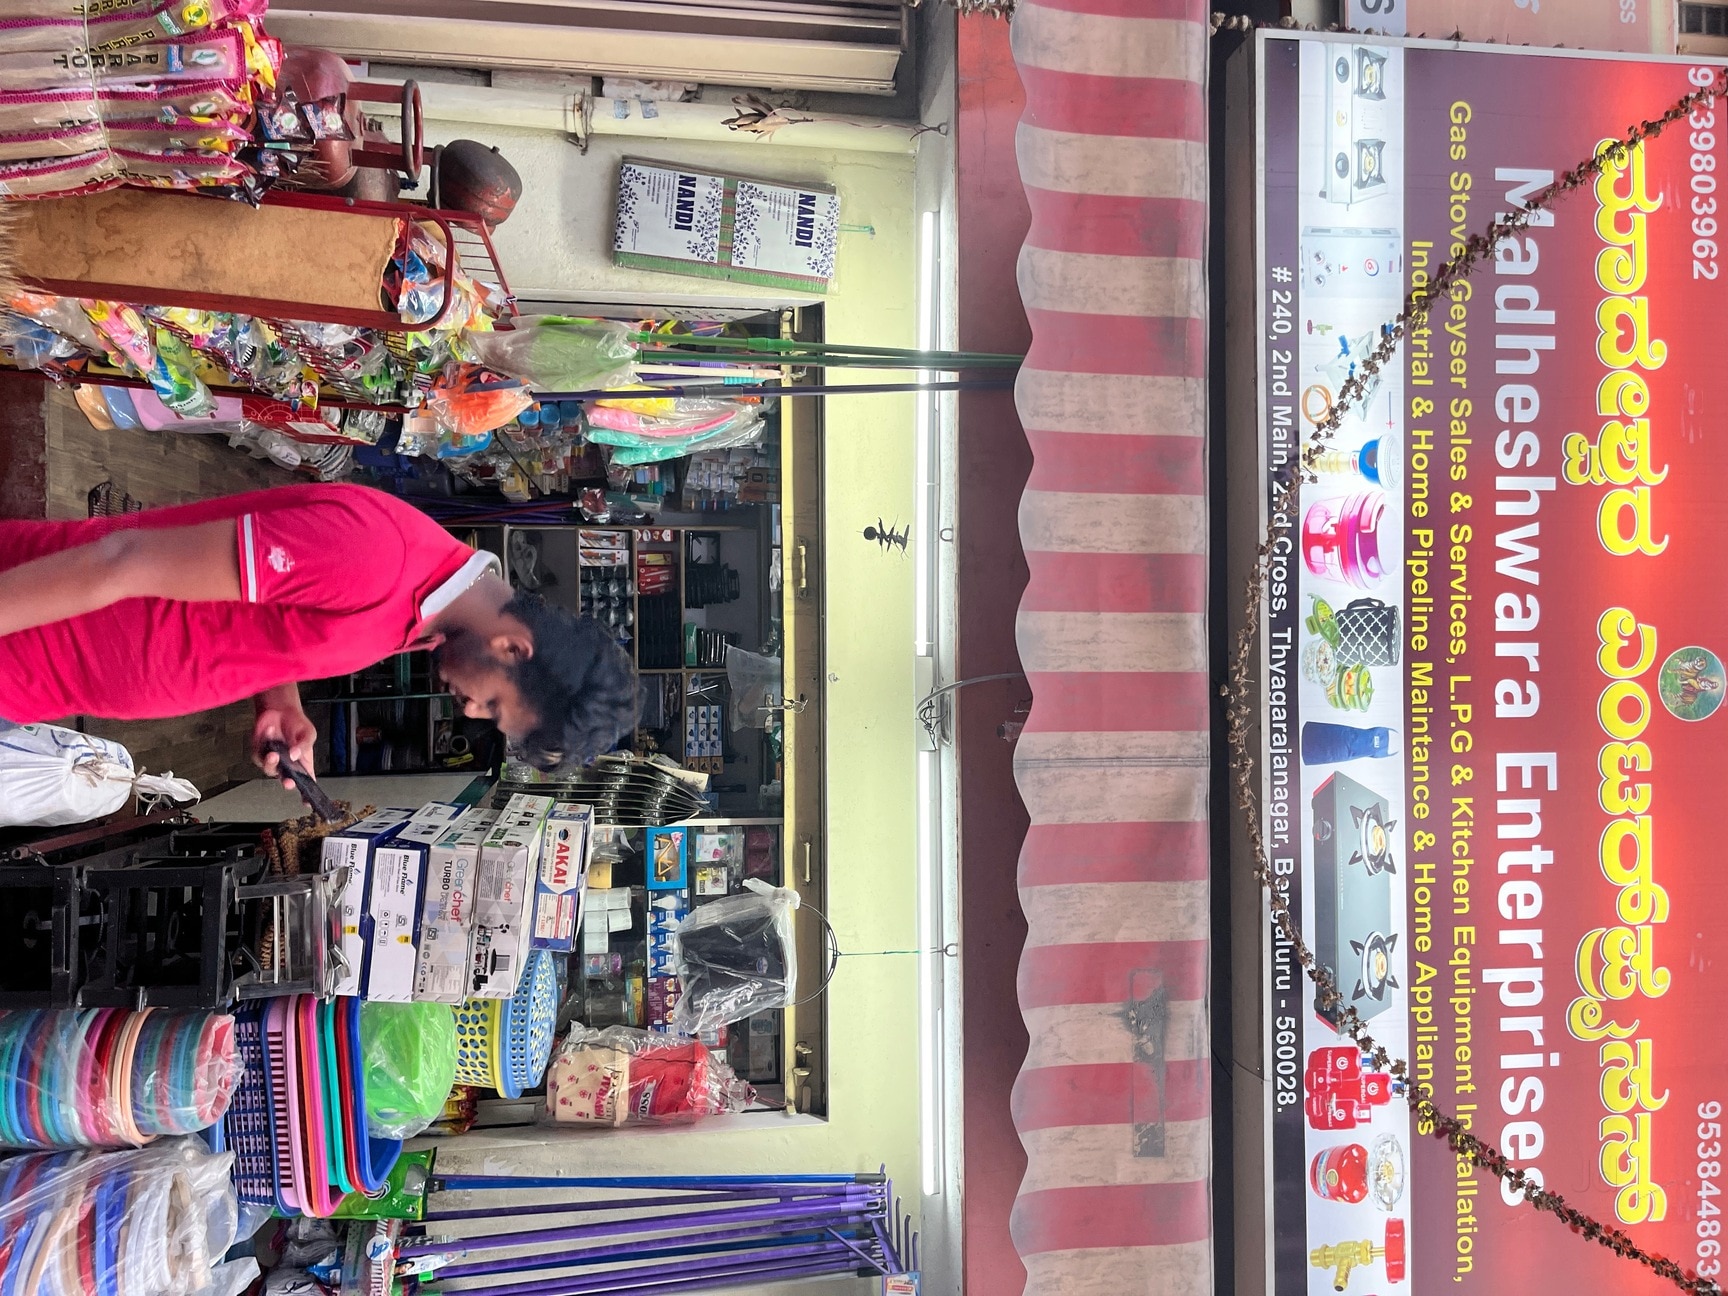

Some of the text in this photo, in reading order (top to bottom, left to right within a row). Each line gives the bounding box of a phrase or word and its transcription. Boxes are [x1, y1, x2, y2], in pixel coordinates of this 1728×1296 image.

[53, 52, 159, 69] PARROT
[1447, 100, 1472, 161] Gas
[673, 174, 697, 232] NANDI
[1687, 67, 1719, 280] 9739803962
[794, 193, 817, 249] NANDI
[1445, 171, 1473, 271] Stove,
[1272, 266, 1293, 283] #
[1268, 289, 1293, 341] 240,
[1444, 278, 1473, 389] Geyser
[1561, 138, 1669, 557] ಮಾದೇಶ್ವರ
[1272, 350, 1293, 397] 2nd
[1410, 396, 1433, 419] &
[1269, 405, 1293, 472] Main,
[1410, 429, 1434, 518] Home
[1448, 398, 1473, 481] Sales
[1449, 491, 1472, 514] &
[1269, 536, 1293, 618] Cross,
[1406, 528, 1435, 651] Pipeline
[1445, 524, 1475, 664] Services,
[1448, 674, 1473, 754] L.P.G
[1482, 167, 1560, 1207] Madheshwara Enterprises
[1268, 627, 1294, 849] Thyagarajanagar,
[1409, 662, 1436, 820] Maintance
[1449, 764, 1474, 788] &
[349, 843, 358, 860] Blue
[399, 854, 410, 895] Blue Flame
[441, 860, 453, 890] TURBO
[553, 842, 571, 885] AKAI
[1412, 830, 1436, 853] &
[1450, 797, 1476, 914] Kitchen
[450, 858, 470, 923] Greenchef
[1412, 863, 1437, 952] Home
[1409, 961, 1438, 1136] Appliances
[1445, 925, 1478, 1095] Equipment
[1274, 1016, 1297, 1113] 560028.
